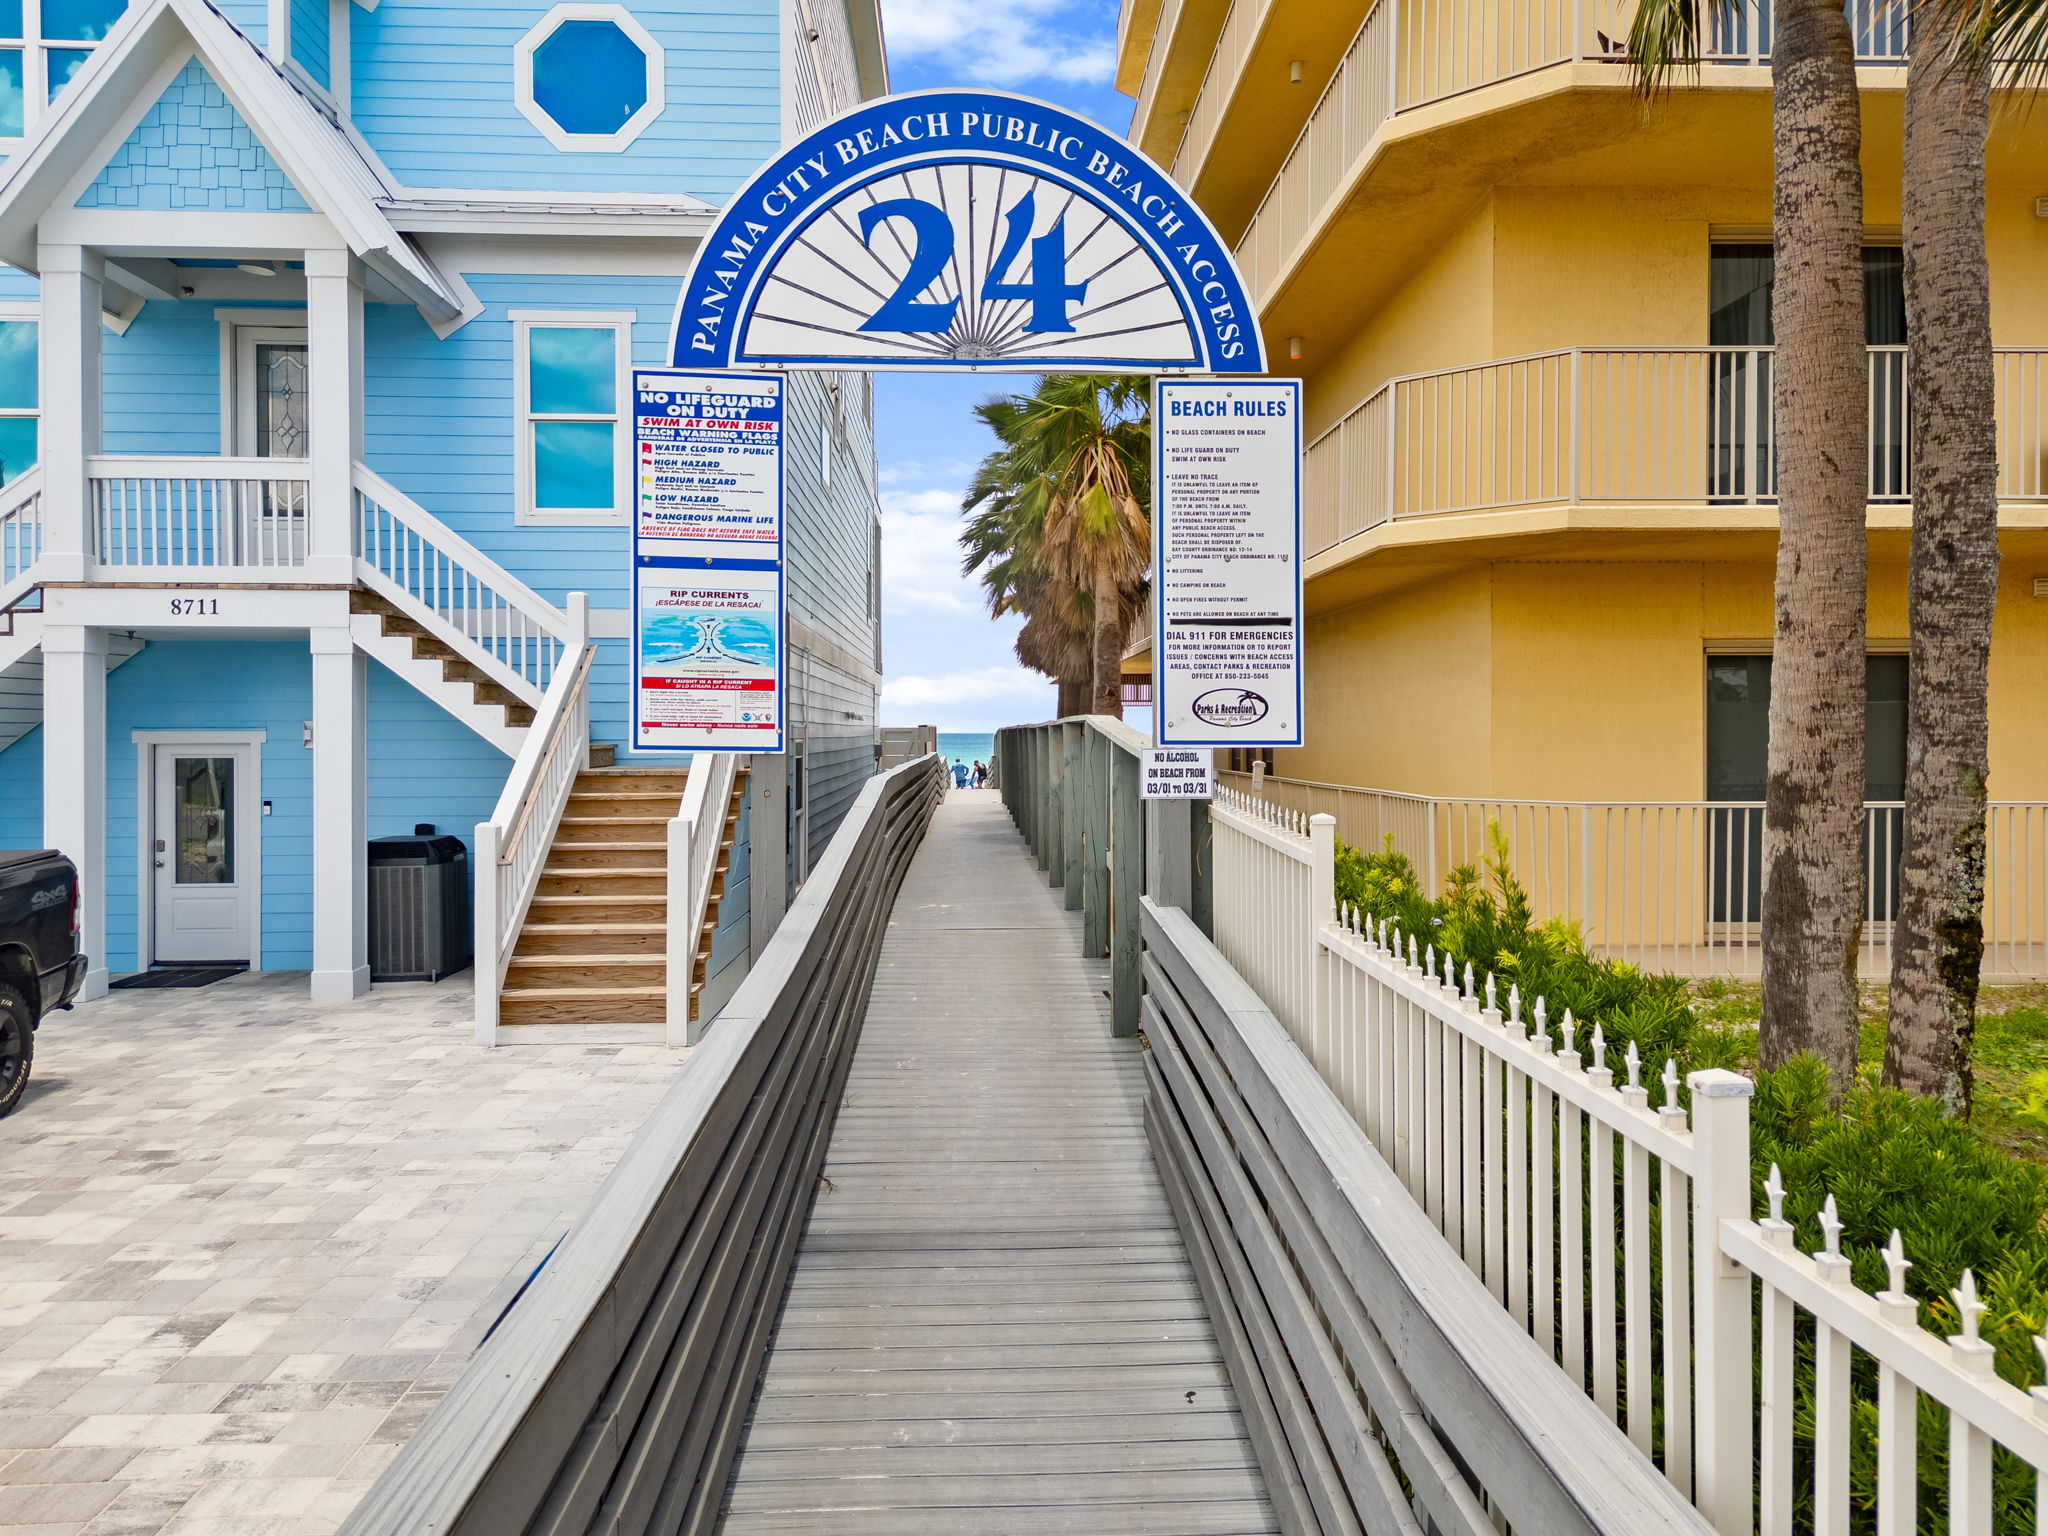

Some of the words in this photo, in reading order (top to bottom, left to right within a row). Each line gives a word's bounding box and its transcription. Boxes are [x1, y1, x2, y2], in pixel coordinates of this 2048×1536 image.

[691, 220, 768, 352] PANAMA
[763, 152, 828, 217] CITY
[834, 111, 949, 165] BEACH
[961, 111, 1084, 161] PUBLIC
[1086, 149, 1184, 240] BEACH
[1176, 244, 1245, 359] ACCESS
[856, 189, 1090, 333] 24
[640, 392, 669, 404] NO
[676, 394, 776, 408] LIFEGUARD
[667, 405, 695, 417] ON
[702, 406, 749, 418] DUTY
[1171, 401, 1226, 416] BEACH
[1234, 401, 1286, 416] RULES
[643, 418, 680, 427] SWIM
[685, 419, 702, 428] AT
[706, 420, 739, 429] OWN
[744, 421, 774, 430] RISK
[637, 428, 674, 437] BEACH
[679, 430, 738, 439] WARNING
[742, 432, 778, 440] FLAGS
[655, 444, 687, 452] WATER
[690, 445, 724, 454] CLOSED
[743, 447, 774, 455] PUBLIC
[681, 460, 720, 468] HAZARD
[655, 476, 694, 484] MEDIUM
[698, 477, 736, 485] HAZARD
[680, 495, 719, 503] HAZARD
[655, 513, 713, 522] DANGEROUS
[716, 515, 753, 523] MARINE
[756, 516, 773, 524] LIFE
[670, 590, 688, 598] RIP
[691, 591, 749, 599] CURRENTS
[171, 598, 219, 615] 8711
[1167, 632, 1186, 640] DIAL
[1189, 632, 1205, 640] 911
[1209, 632, 1226, 640] FOR
[1230, 632, 1293, 640] EMERGENCIES
[1197, 704, 1214, 713] Parks
[1215, 704, 1219, 713] &
[1221, 704, 1252, 713] Recreation
[1155, 753, 1164, 762] NO
[1166, 753, 1199, 762] ALCOHOL
[1148, 768, 1158, 777] ON
[1160, 768, 1184, 777] BEACH
[1185, 768, 1205, 777] FROM
[1147, 783, 1171, 794] 03/01
[1173, 785, 1181, 794] TO
[1183, 783, 1207, 794] 03/31
[31, 884, 67, 904] 4x4
[0, 1059, 28, 1107] BFGoodr
